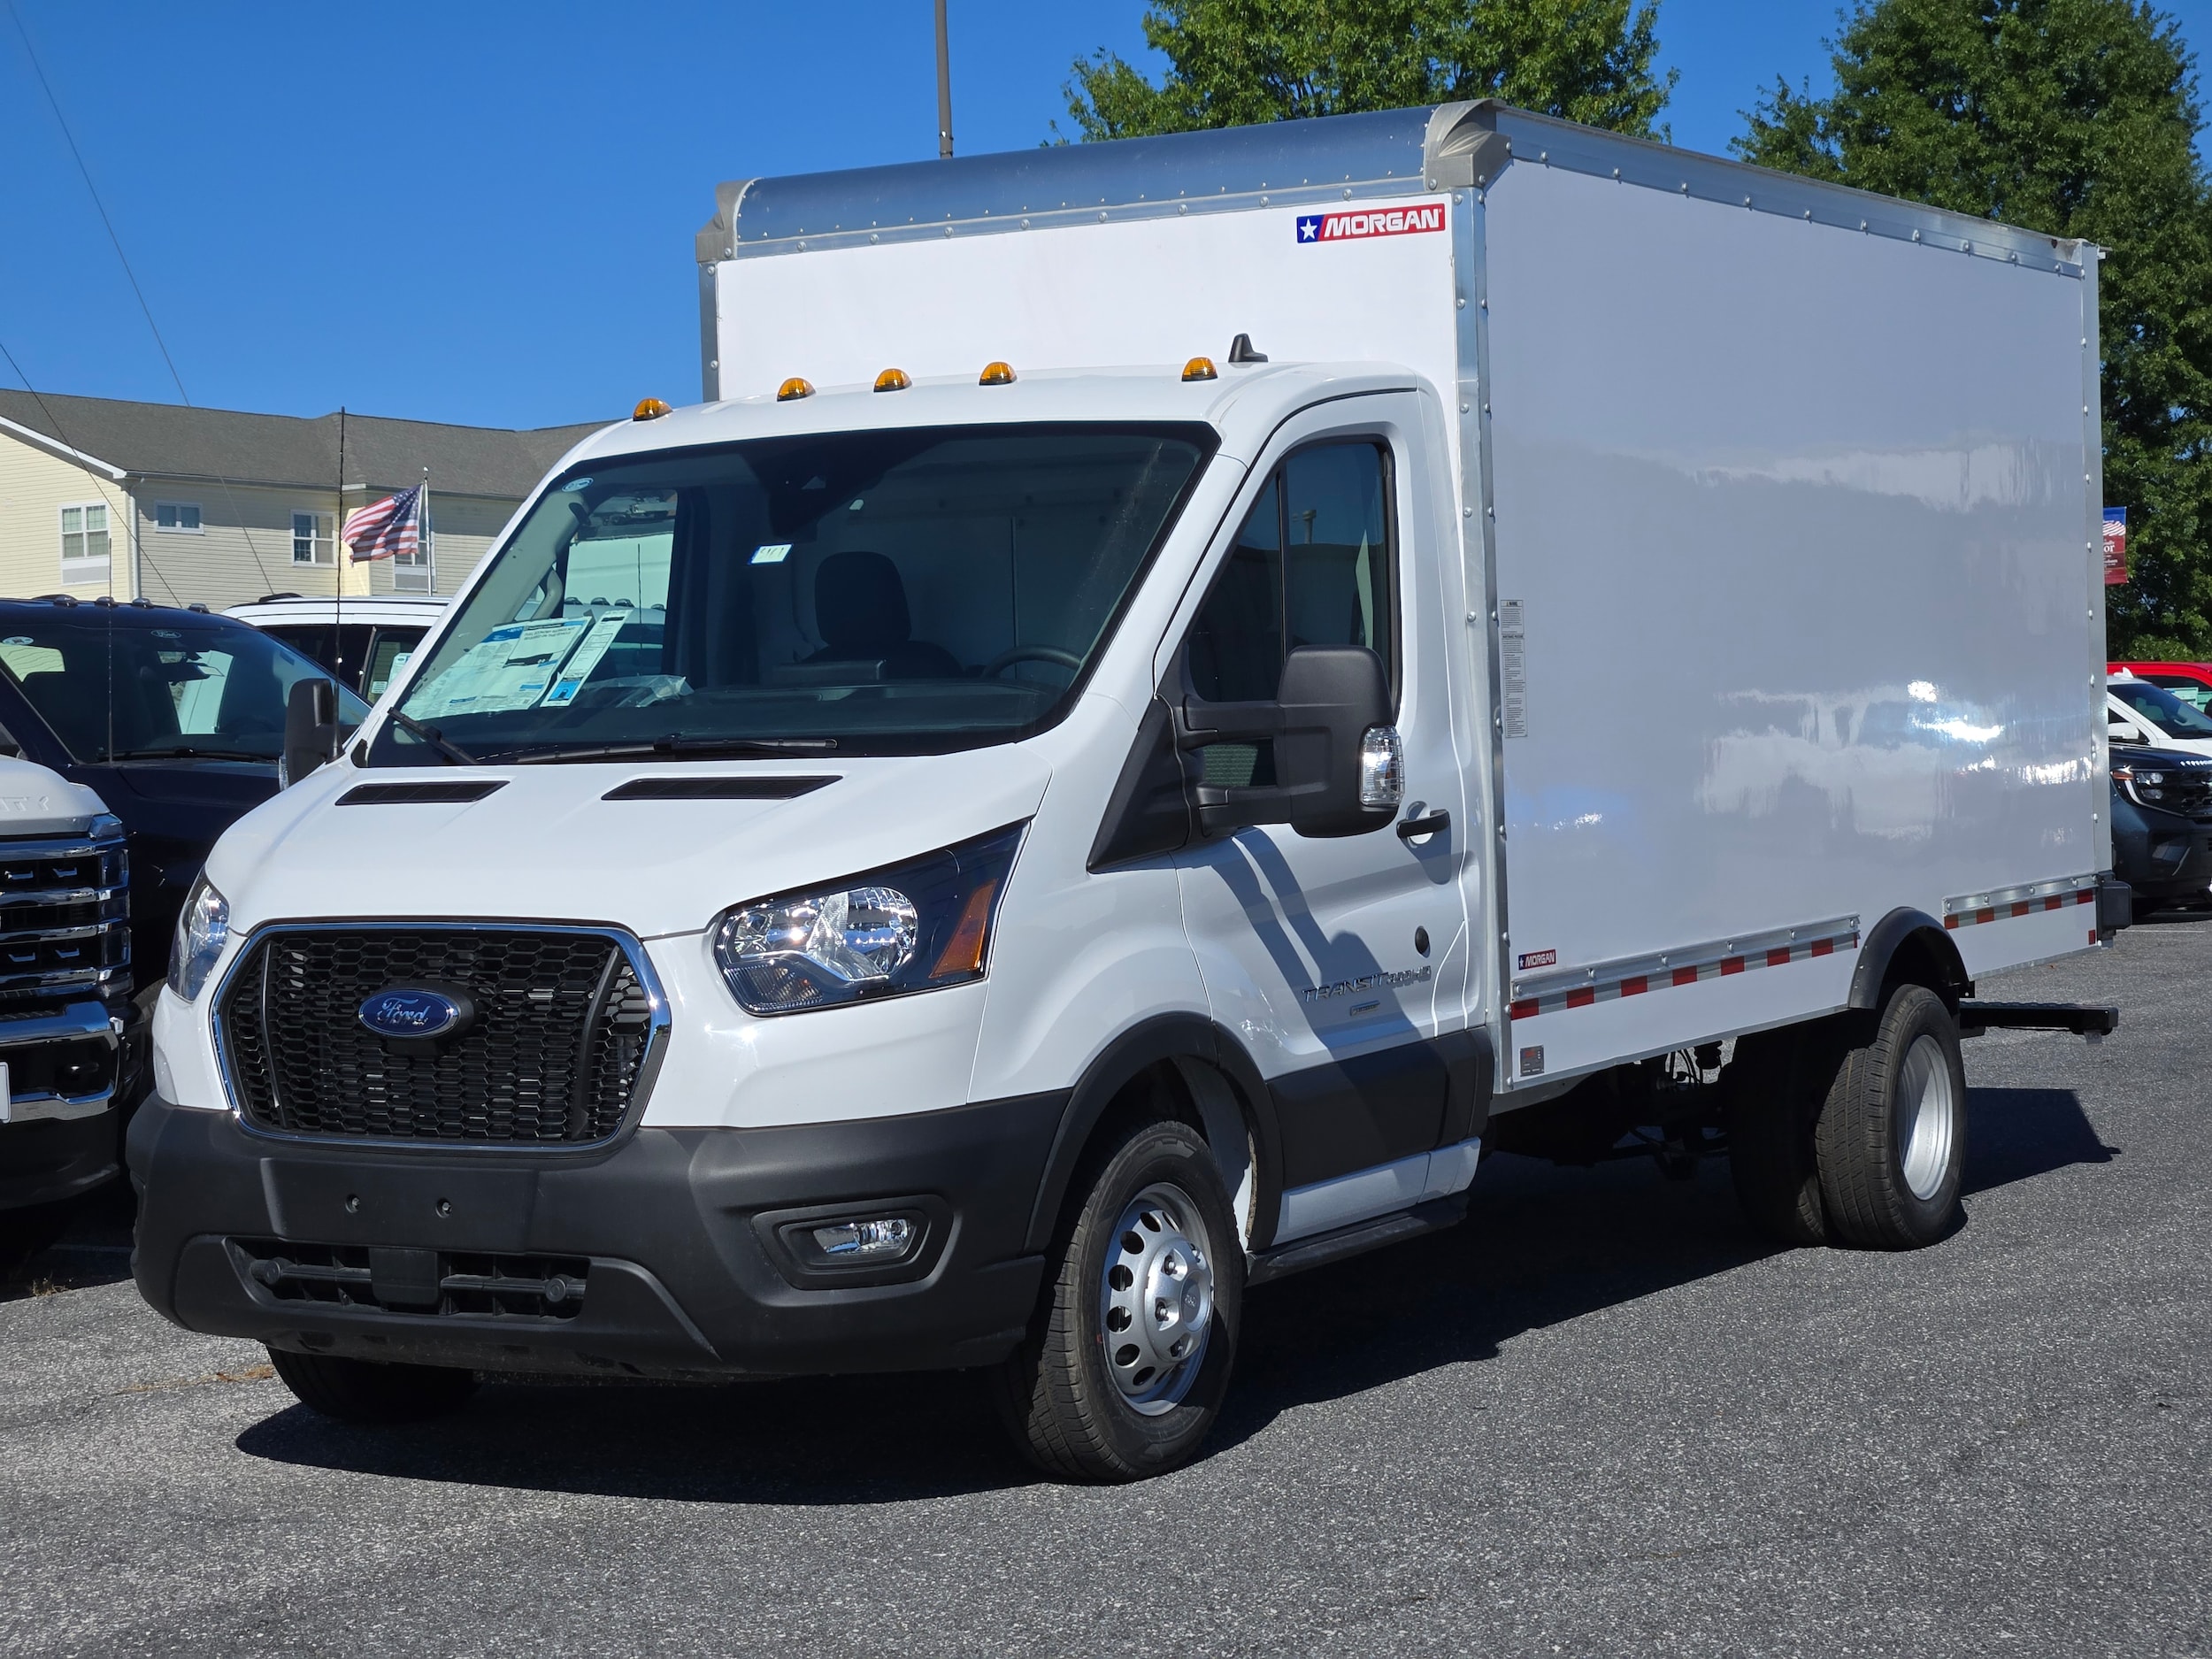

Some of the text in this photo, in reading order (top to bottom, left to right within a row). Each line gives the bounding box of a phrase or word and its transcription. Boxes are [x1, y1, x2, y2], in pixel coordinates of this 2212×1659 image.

[1324, 208, 1440, 238] MORGAN
[1525, 951, 1555, 968] MORGAN
[1302, 972, 1388, 1002] TRANSIT
[375, 997, 432, 1025] Ford
